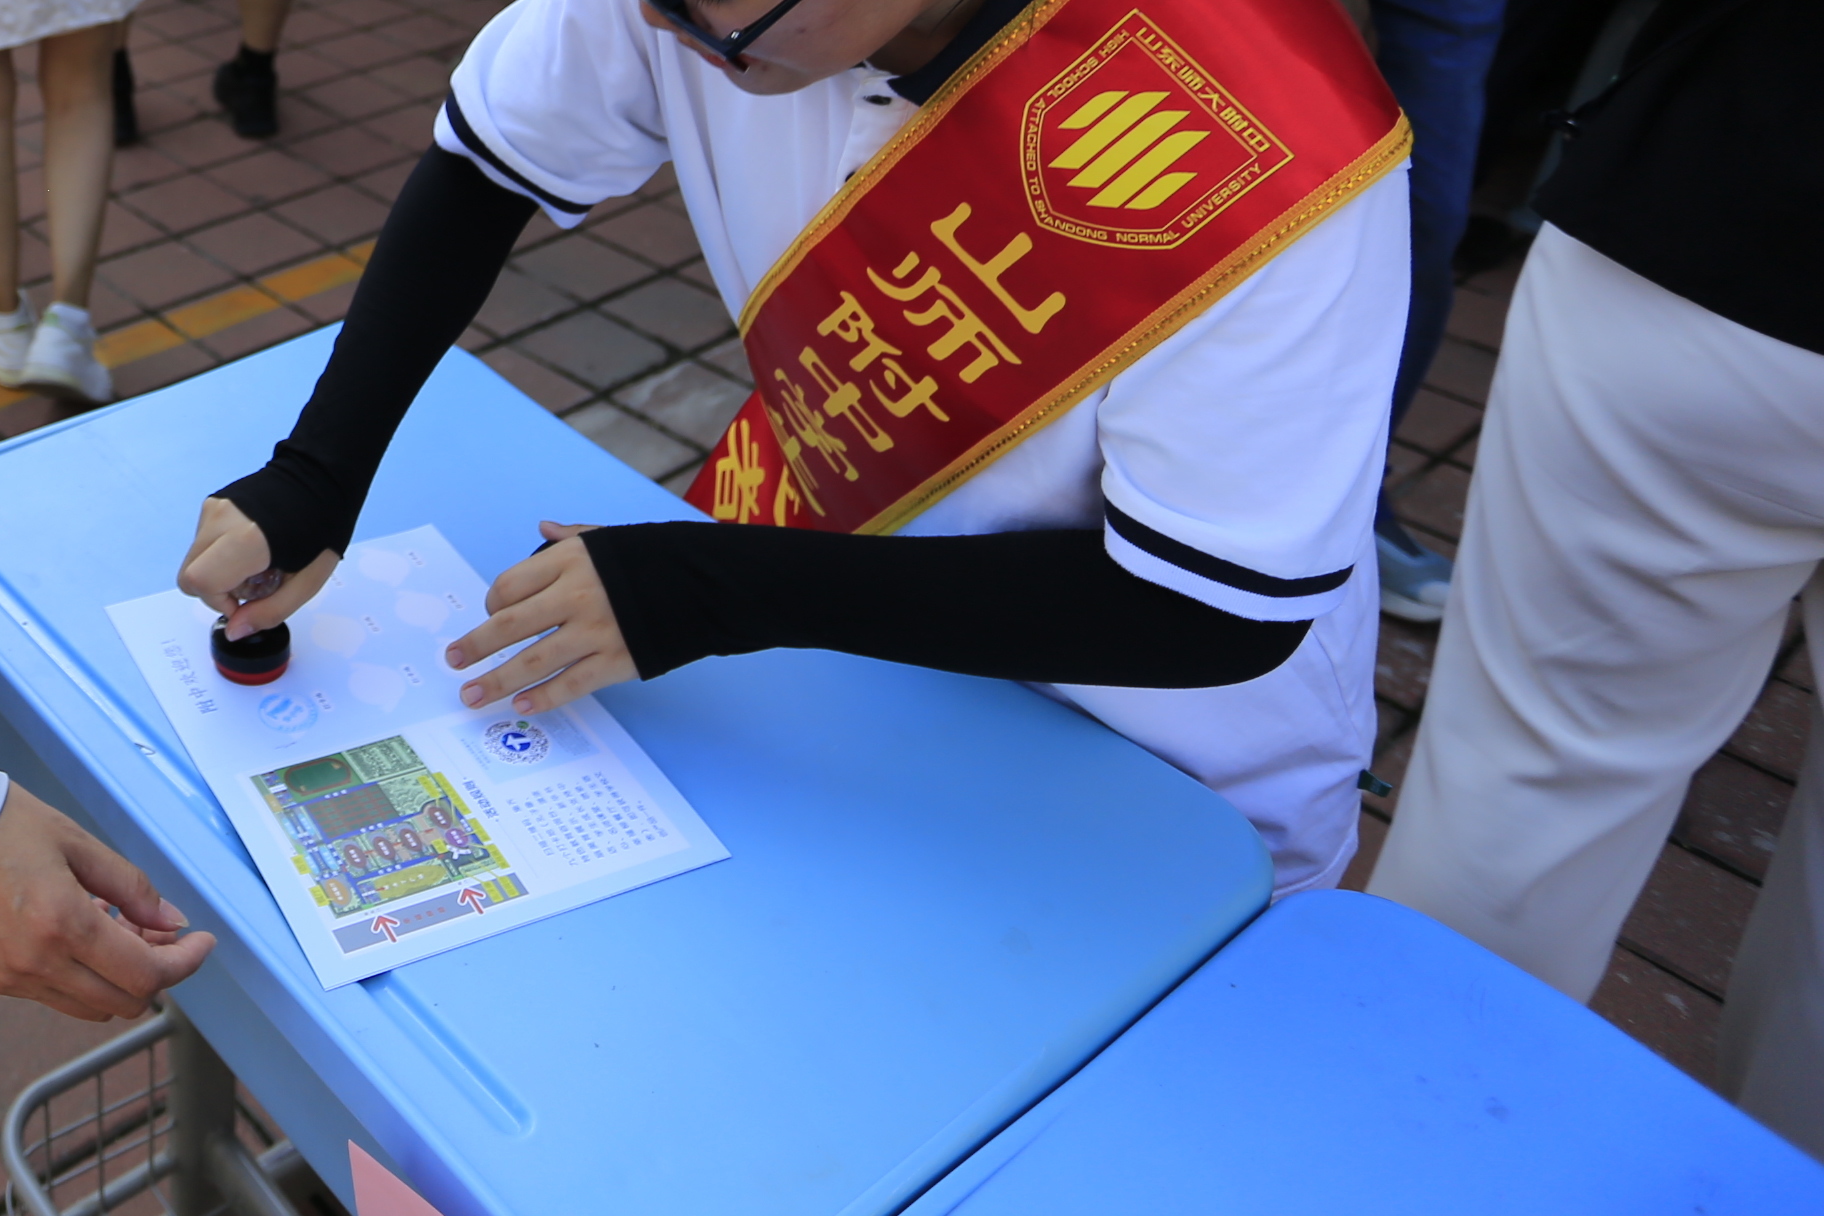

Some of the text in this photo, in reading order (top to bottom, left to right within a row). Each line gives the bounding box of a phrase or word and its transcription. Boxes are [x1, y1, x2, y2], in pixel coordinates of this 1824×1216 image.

[1026, 30, 1263, 244] HIGH SCHOOL ATTACHED TO SHANDONG NORMAL UNIVERSITY
[1135, 27, 1271, 153] 山东师大附中
[462, 779, 500, 820] 活动规则
